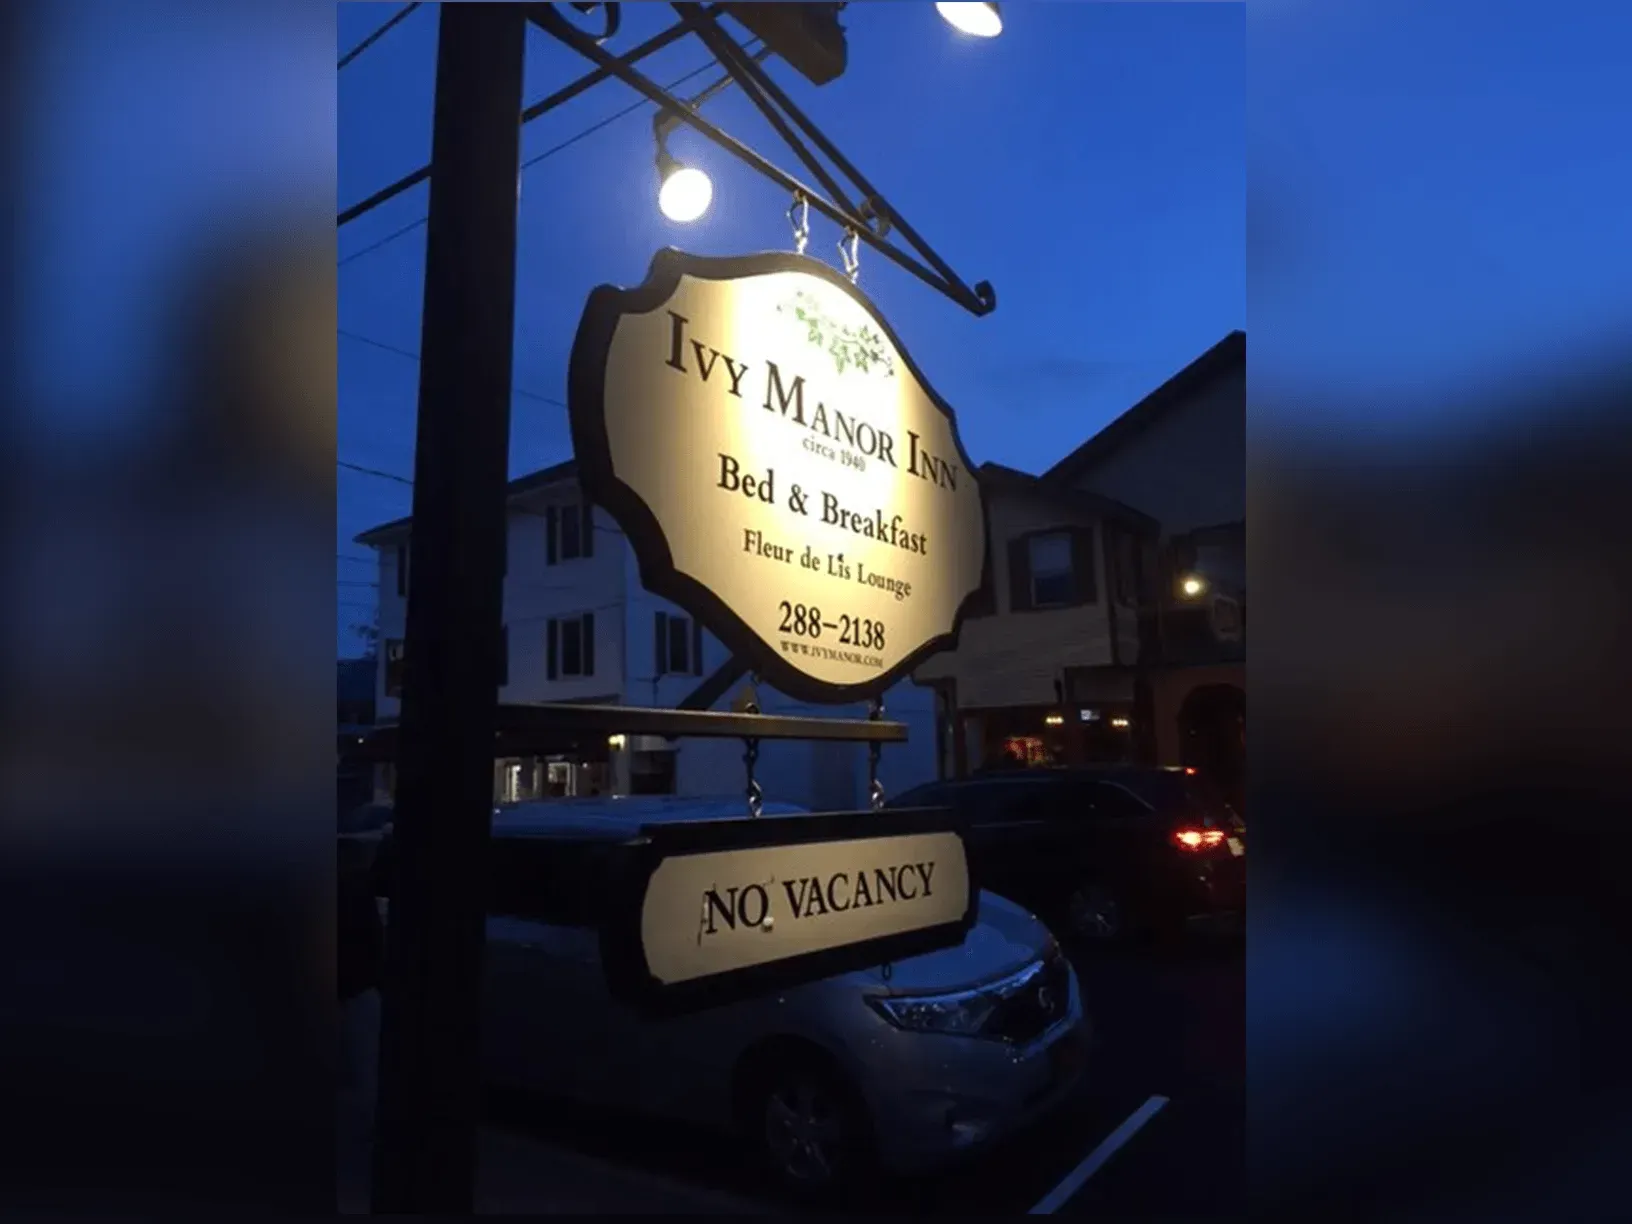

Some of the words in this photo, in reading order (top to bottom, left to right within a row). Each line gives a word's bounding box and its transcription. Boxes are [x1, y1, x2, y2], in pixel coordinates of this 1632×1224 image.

[665, 310, 748, 397] IVY
[762, 361, 898, 468] MANOR
[906, 430, 958, 492] INN
[802, 436, 836, 461] circa
[840, 449, 866, 472] 1940
[717, 453, 775, 505] Bed
[788, 484, 809, 516] &
[820, 492, 928, 556] Breakfast
[743, 529, 793, 564] Fleur
[800, 545, 821, 572] de
[827, 553, 851, 581] Lis
[857, 563, 912, 601] Lounge
[778, 601, 885, 651] 288-2138
[780, 640, 884, 668] WWW.IVYMANOR.COM
[705, 883, 769, 934] NO
[782, 862, 936, 919] VACANCY
